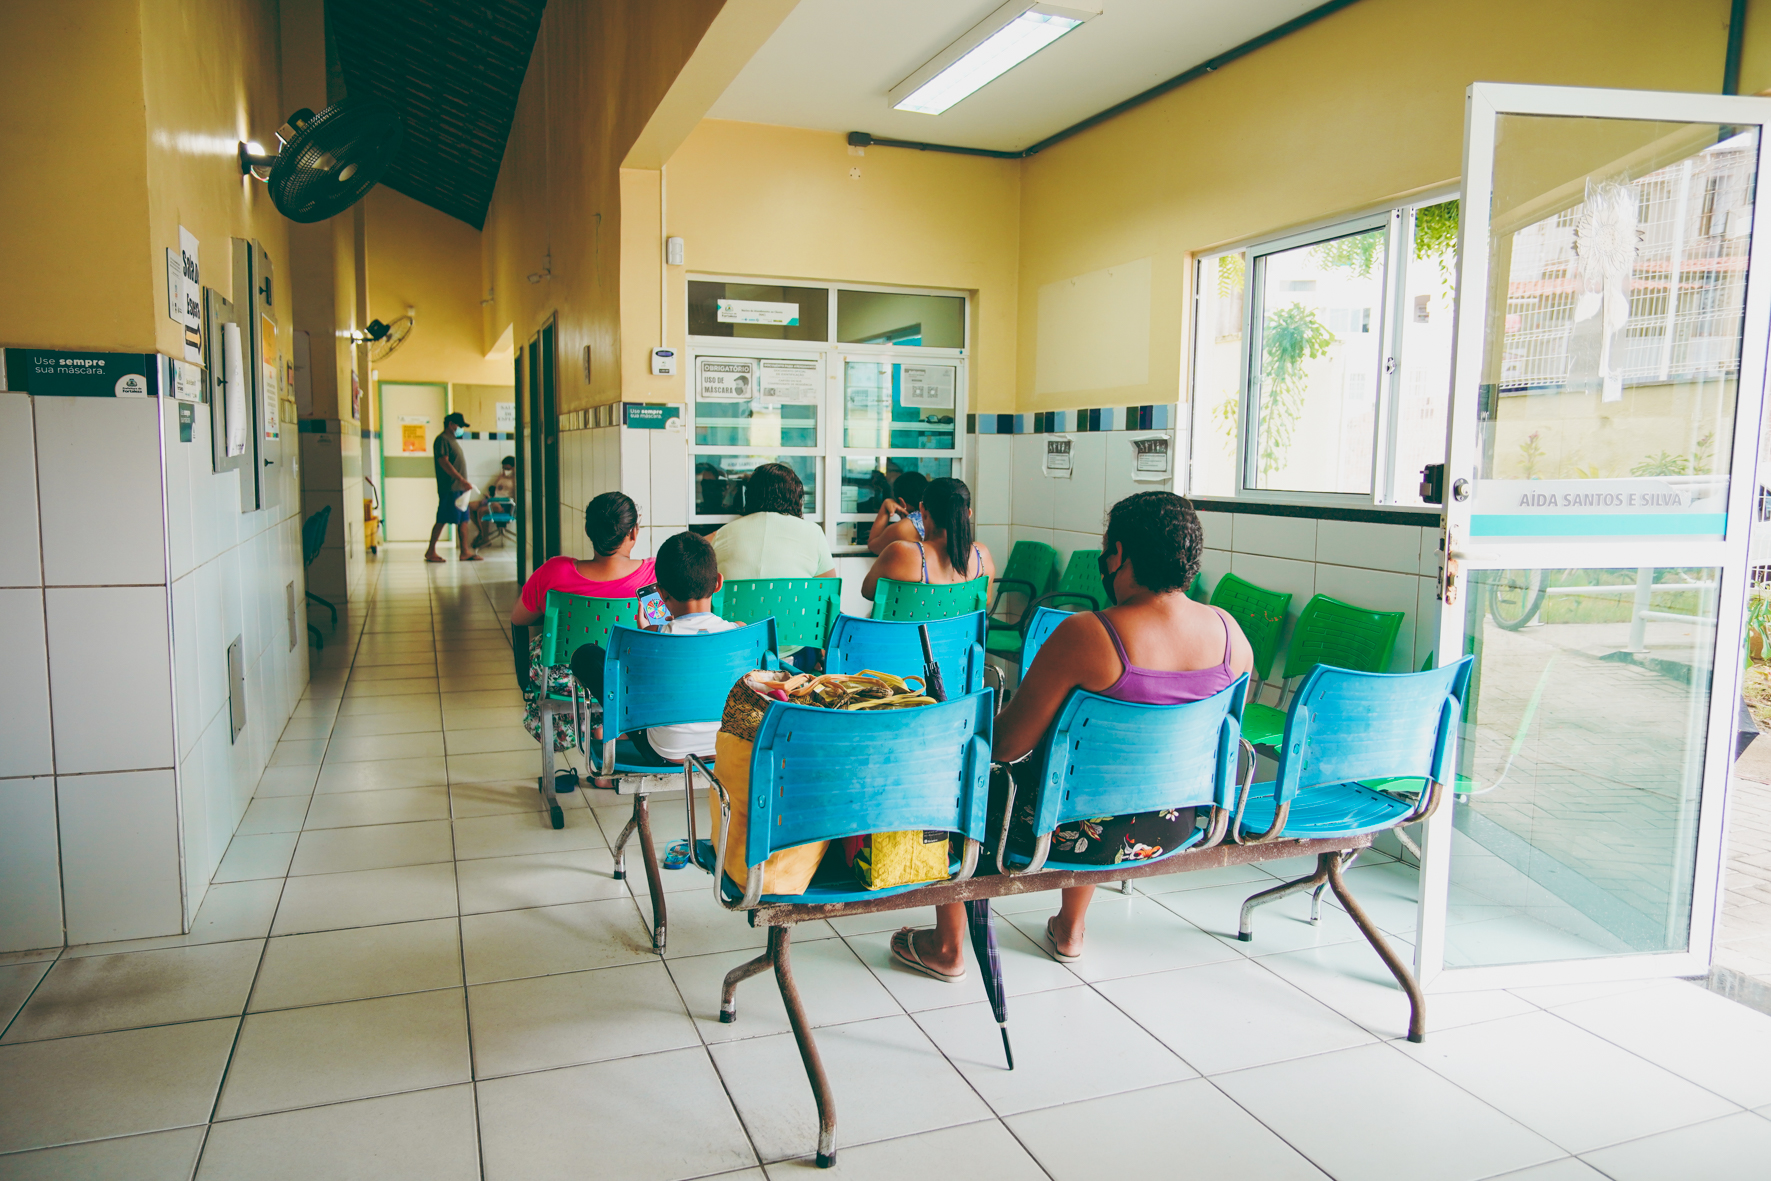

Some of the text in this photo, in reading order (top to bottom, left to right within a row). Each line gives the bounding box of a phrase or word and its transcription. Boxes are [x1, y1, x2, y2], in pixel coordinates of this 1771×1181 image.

[182, 249, 194, 282] Sala
[34, 357, 105, 368] Use sempre
[35, 366, 105, 375] sua máscara.
[704, 365, 749, 373] OBRIGATÓRIO
[704, 385, 733, 394] MÁSCARA
[1519, 490, 1682, 507] AÍDA SANTOS E SILVA
